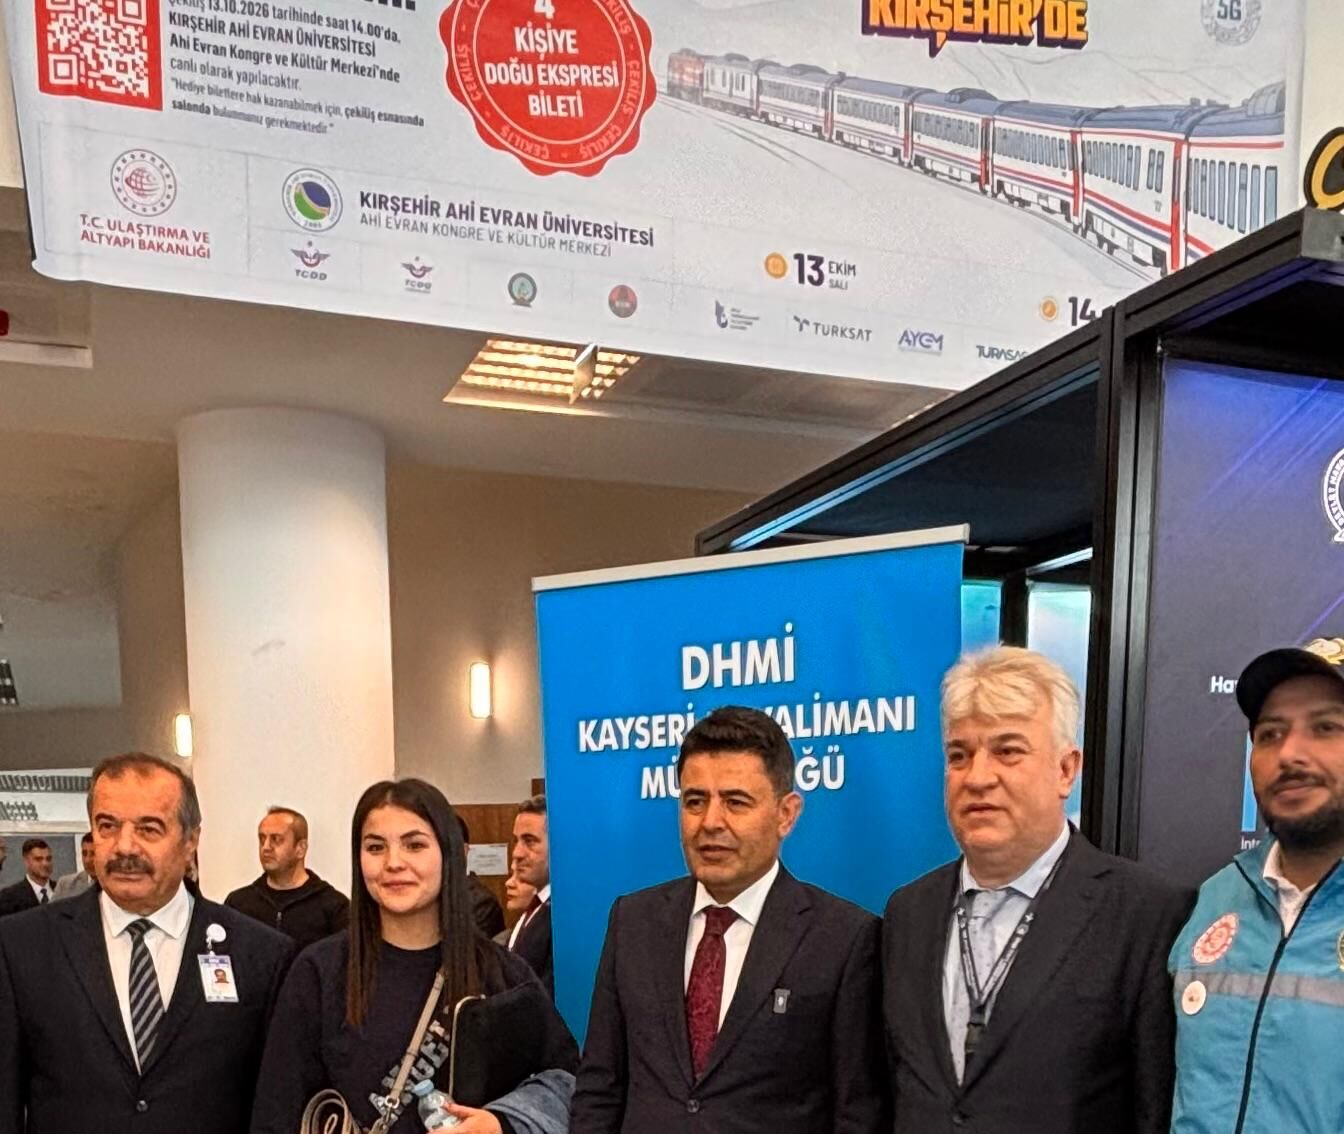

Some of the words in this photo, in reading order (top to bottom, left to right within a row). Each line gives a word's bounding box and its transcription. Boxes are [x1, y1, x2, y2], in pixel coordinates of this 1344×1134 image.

[169, 11, 225, 35] KIRŞEHİR
[229, 20, 250, 38] AHİ
[253, 25, 293, 45] EVRAN
[296, 30, 376, 57] ÜNİVERSİTESİ
[272, 5, 323, 26] tarihinde
[326, 15, 349, 31] saat
[169, 33, 190, 49] Ahi
[193, 38, 227, 56] Evran
[230, 43, 272, 65] Kongre
[275, 55, 288, 67] ve
[291, 53, 327, 71] Kültür
[514, 21, 579, 60] KİŞİYE
[170, 57, 197, 73] canlı
[200, 63, 233, 80] olarak
[484, 57, 533, 85] DOĞU
[537, 61, 619, 87] EKSPRESİ
[528, 90, 584, 118] BİLETİ
[107, 219, 189, 241] ULAŞTIRMA
[192, 230, 211, 244] VE
[359, 190, 441, 218] KIRŞEHİR
[445, 200, 476, 222] AHİ
[479, 206, 539, 231] EVRAN
[542, 210, 655, 248] ÜNİVERSİTESİ
[360, 212, 382, 228] AHİ
[385, 216, 429, 235] EVRAN
[432, 221, 485, 242] KONGRE
[488, 228, 505, 244] VE
[507, 230, 557, 250] KÜLTÜR
[559, 238, 613, 258] MERKEZİ
[80, 230, 136, 250] ALTYAPI
[138, 238, 212, 260] BAKANLIĞI
[793, 253, 825, 287] 13
[827, 259, 857, 278] EKİM
[1068, 296, 1097, 327] 14
[682, 622, 796, 691] DHMİ
[578, 702, 695, 753] KAYSERİ
